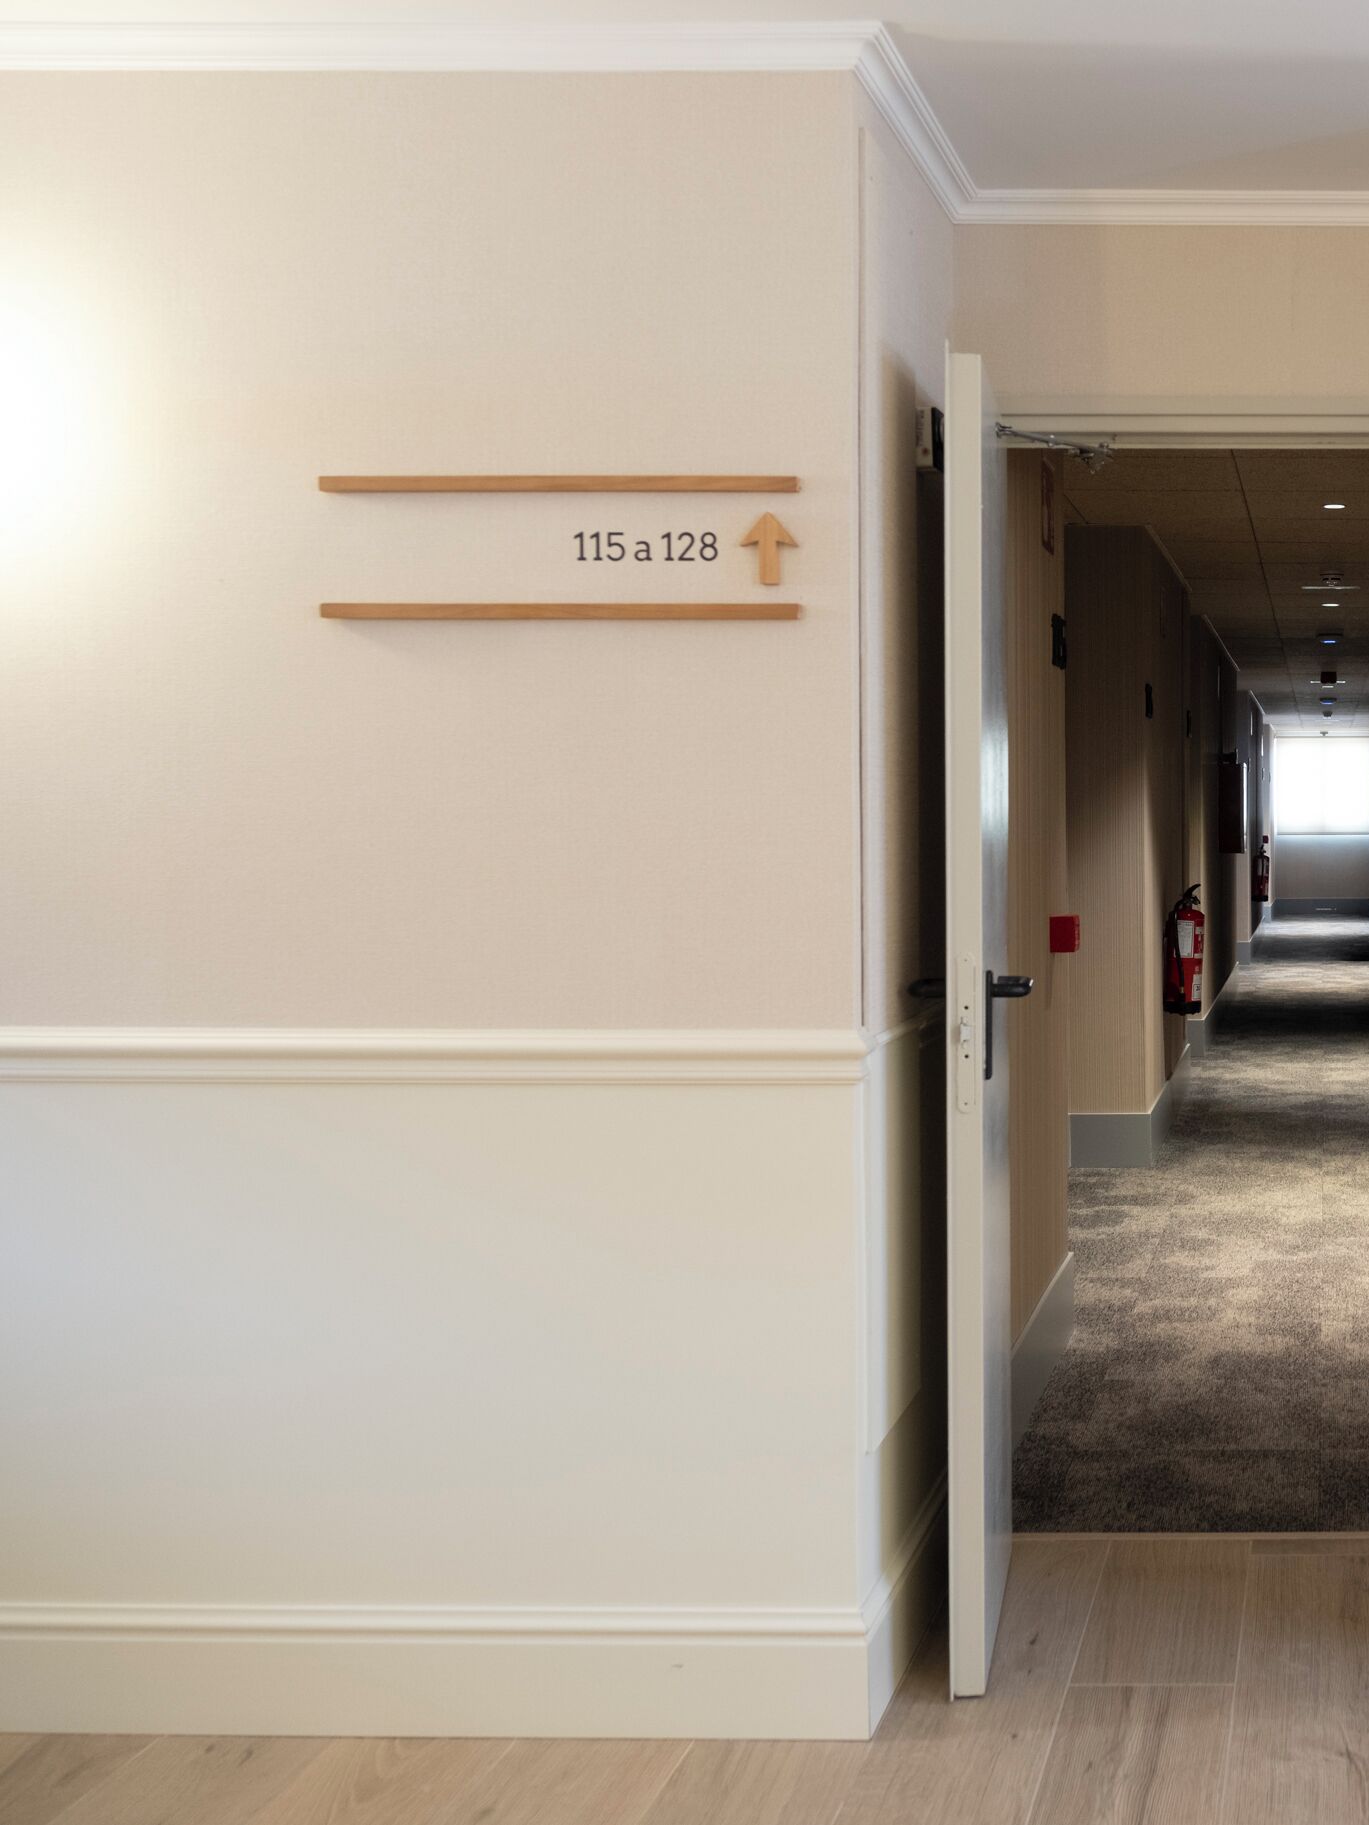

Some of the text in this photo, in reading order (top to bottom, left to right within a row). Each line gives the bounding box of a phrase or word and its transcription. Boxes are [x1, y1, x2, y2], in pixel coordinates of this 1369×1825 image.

[573, 531, 719, 562] 115 a 128
